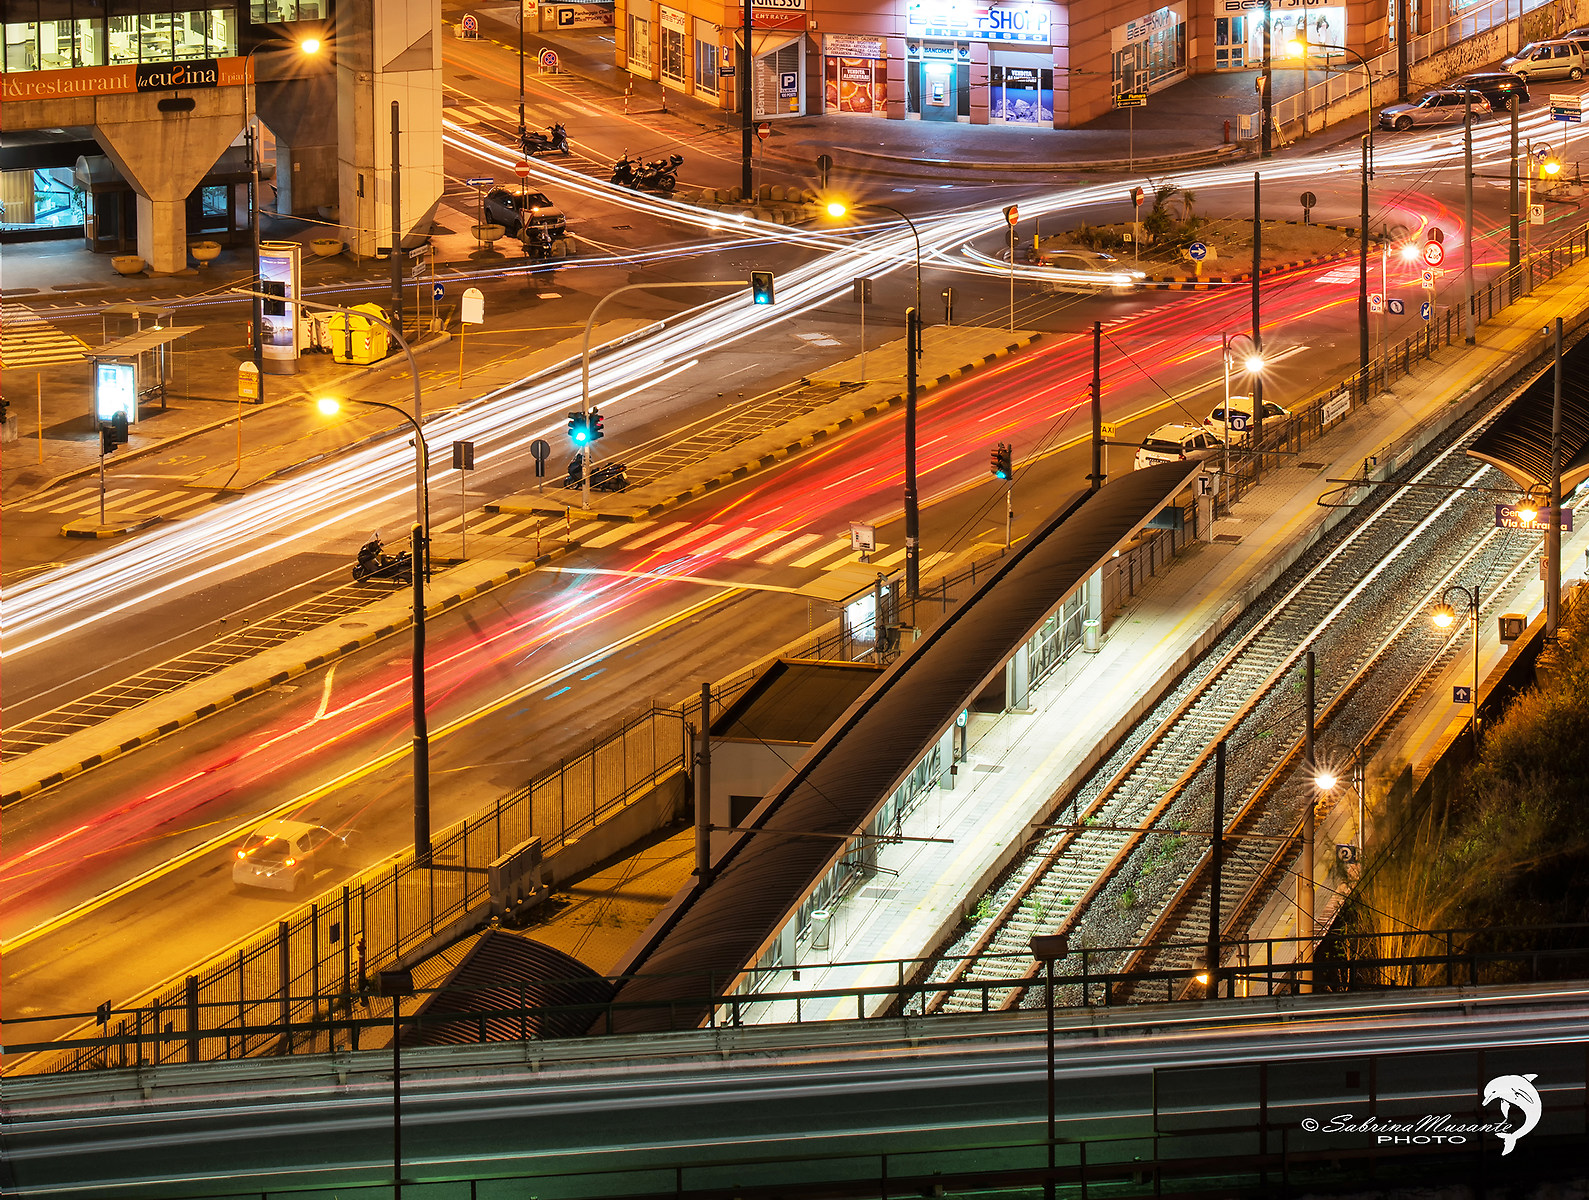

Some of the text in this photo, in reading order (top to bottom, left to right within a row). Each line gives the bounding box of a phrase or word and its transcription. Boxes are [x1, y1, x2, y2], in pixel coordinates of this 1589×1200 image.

[909, 13, 989, 28] BEST
[930, 29, 1043, 42] INGRESSO
[1127, 21, 1152, 40] BEST
[924, 47, 953, 55] BANCOMAT
[756, 60, 765, 116] Benvenuti
[1101, 425, 1115, 434] AXI
[1501, 518, 1518, 528] Via
